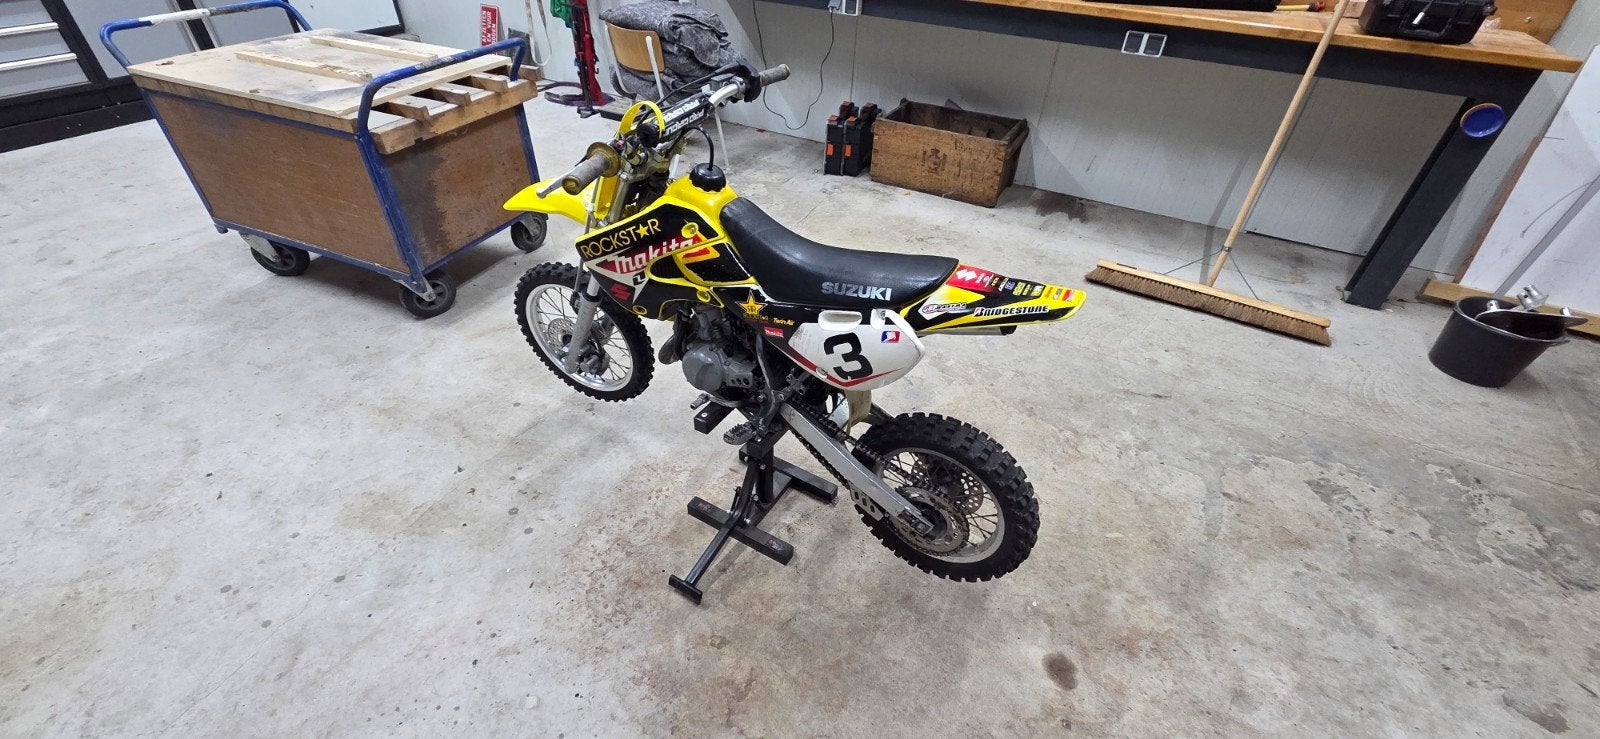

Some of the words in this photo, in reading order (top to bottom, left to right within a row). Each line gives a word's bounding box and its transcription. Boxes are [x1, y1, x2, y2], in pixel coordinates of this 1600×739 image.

[690, 108, 705, 123] PRO
[821, 281, 893, 302] SUZUKI
[974, 305, 1049, 317] BRIDGESTONE
[823, 332, 874, 380] 3
